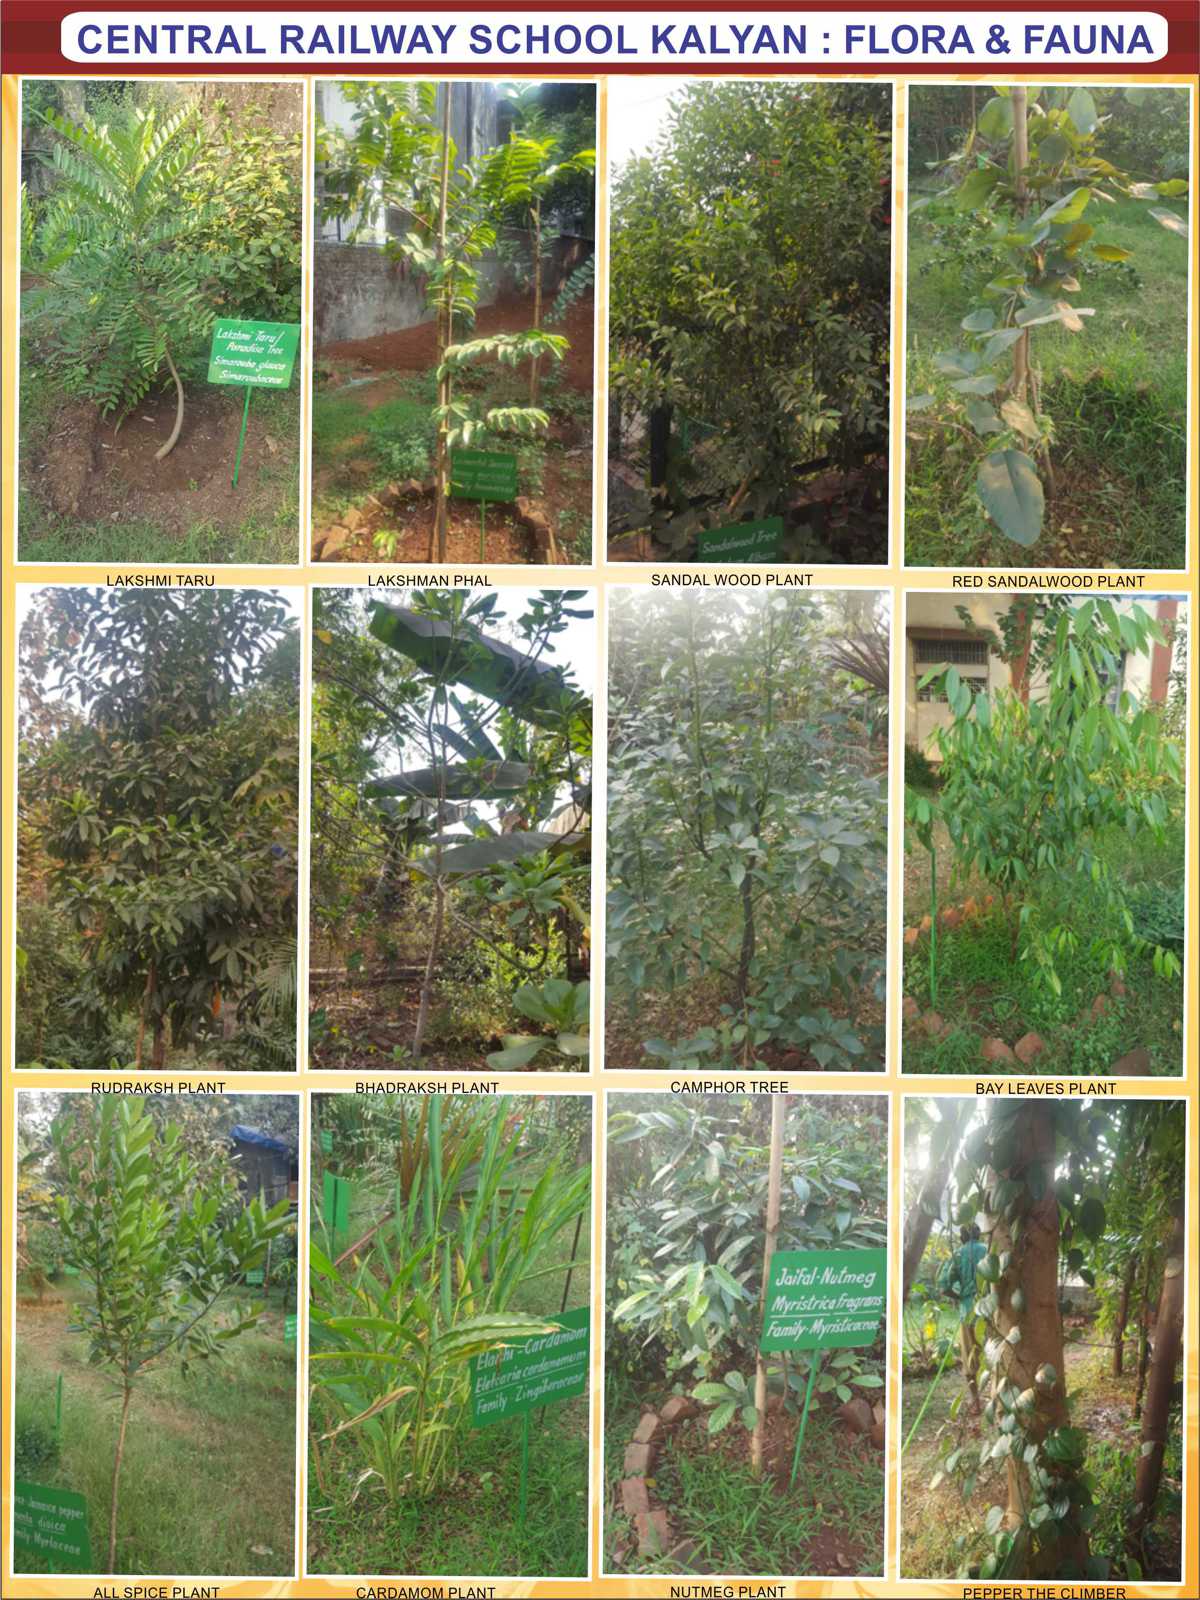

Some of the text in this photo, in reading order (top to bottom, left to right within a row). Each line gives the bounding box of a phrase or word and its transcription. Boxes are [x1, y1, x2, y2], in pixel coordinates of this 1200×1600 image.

[77, 24, 1154, 55] CENTRAL RAILWAY SCHOOL KALYAN : FLORA & FAUNA
[106, 574, 215, 587] LAKSHMI TARU
[368, 574, 492, 587] LAKSHMAN PHAL
[651, 574, 813, 587] SANDAL WOOD PLANT
[952, 575, 1145, 588] RED SANDALWOOD PLANT
[91, 1082, 226, 1095] RUDRAKSH PLANT
[355, 1082, 499, 1095] BHADRAKSH PLANT
[670, 1081, 789, 1094] CAMPHOR TREE
[976, 1082, 1117, 1095] BAY LEAVES PLANT
[477, 1392, 507, 1416] Family
[92, 1586, 220, 1598] ALL SPICE PLANT
[356, 1587, 496, 1599] CARDAMOM PLANT
[670, 1586, 787, 1598] NUTMEG PLANT
[963, 1588, 1127, 1600] PEPPER THE CLIMBER
